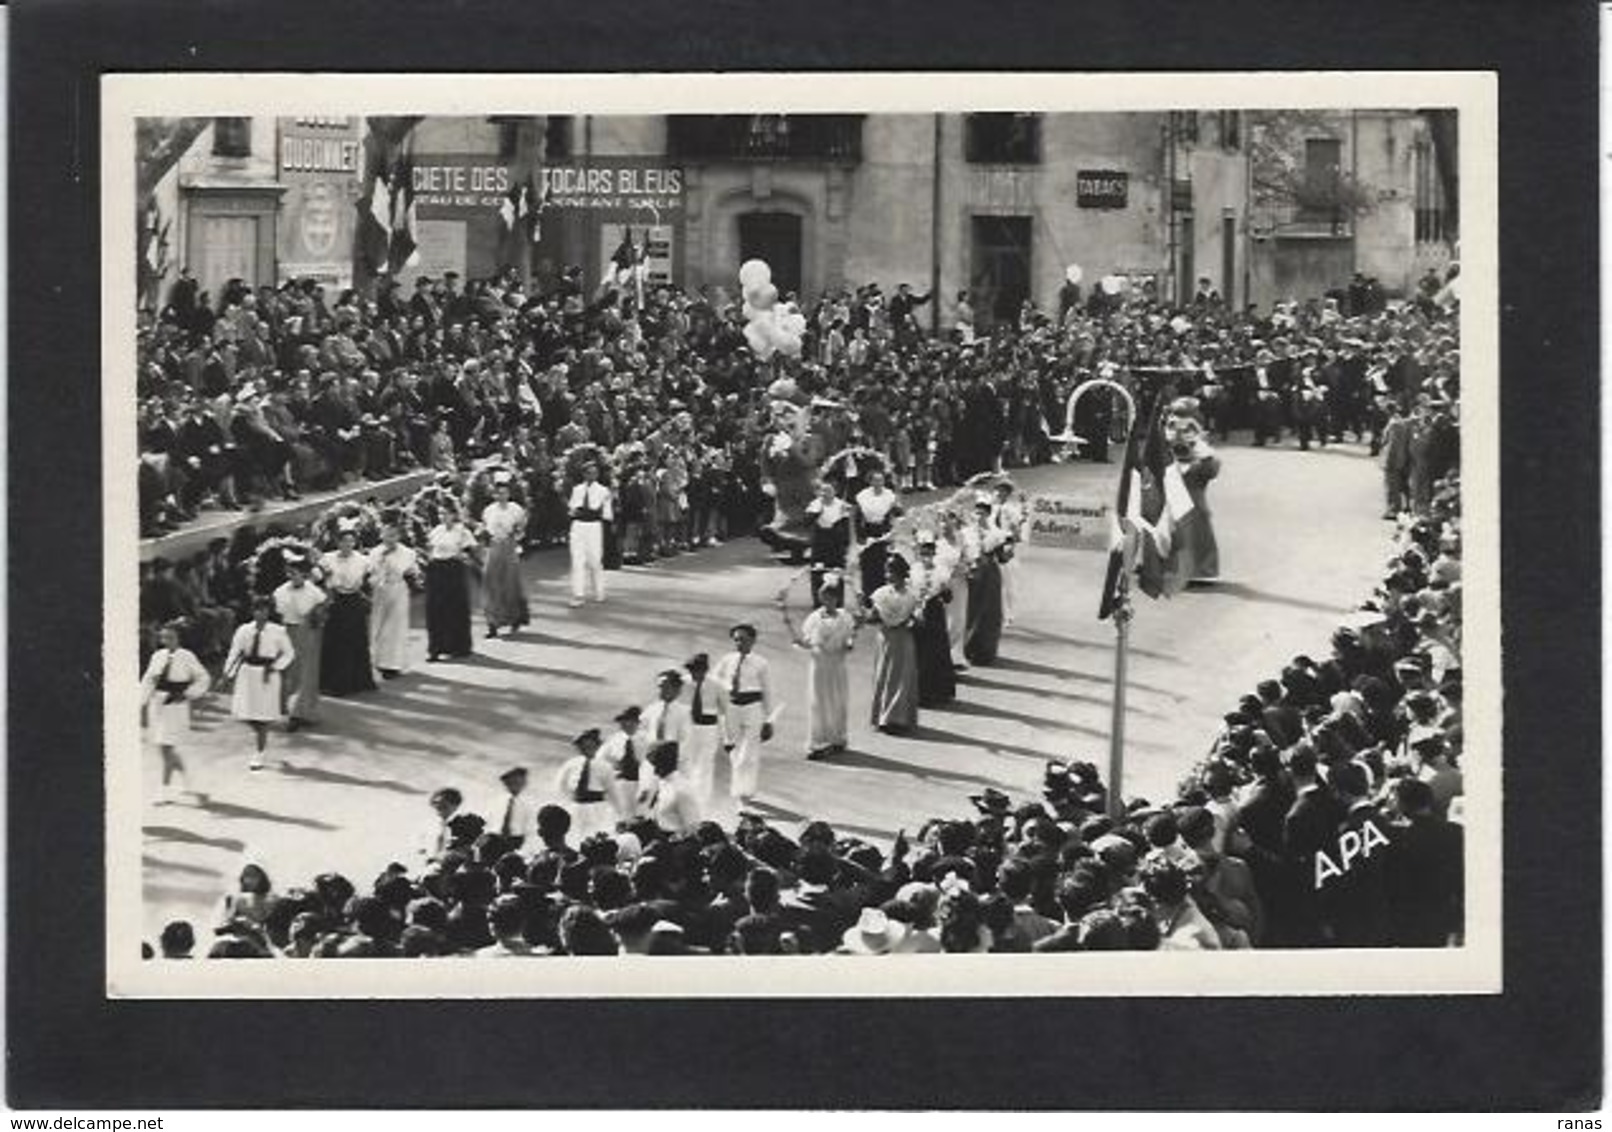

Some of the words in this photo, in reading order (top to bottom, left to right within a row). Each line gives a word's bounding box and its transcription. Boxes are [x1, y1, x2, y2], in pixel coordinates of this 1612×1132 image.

[283, 137, 359, 171] DUBONNET
[412, 167, 466, 191] CIETE
[471, 167, 508, 191] DES
[541, 168, 612, 194] TOCARS
[619, 168, 681, 194] BLEUS
